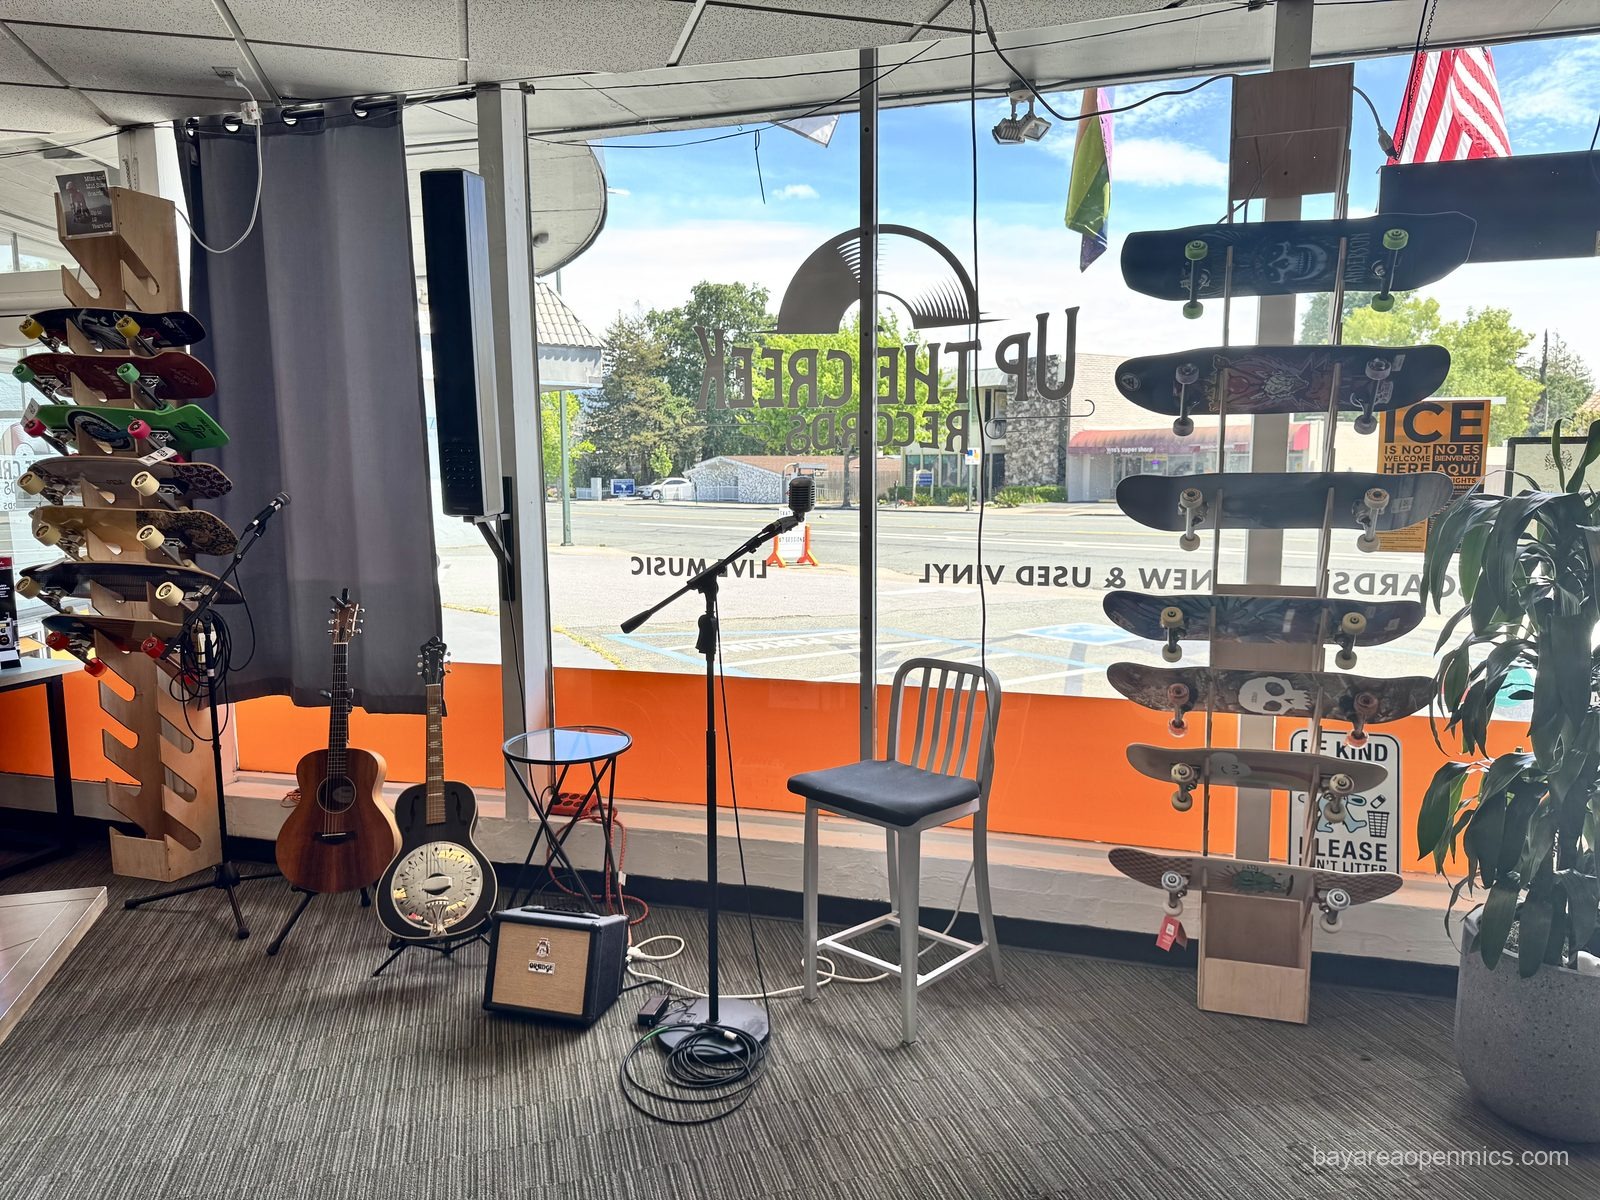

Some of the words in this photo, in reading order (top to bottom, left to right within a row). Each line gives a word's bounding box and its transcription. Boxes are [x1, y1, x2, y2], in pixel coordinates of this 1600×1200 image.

[1344, 232, 1371, 284] ANDERSON
[1384, 402, 1484, 443] ICE
[1384, 445, 1397, 455] IS
[1402, 445, 1431, 455] NOT
[1435, 444, 1458, 454] NO
[1462, 444, 1480, 454] ES
[1384, 455, 1431, 463] WELCOME
[1383, 463, 1430, 474] HERE
[1437, 461, 1478, 476] AQUÍ
[1336, 741, 1388, 762] KIND
